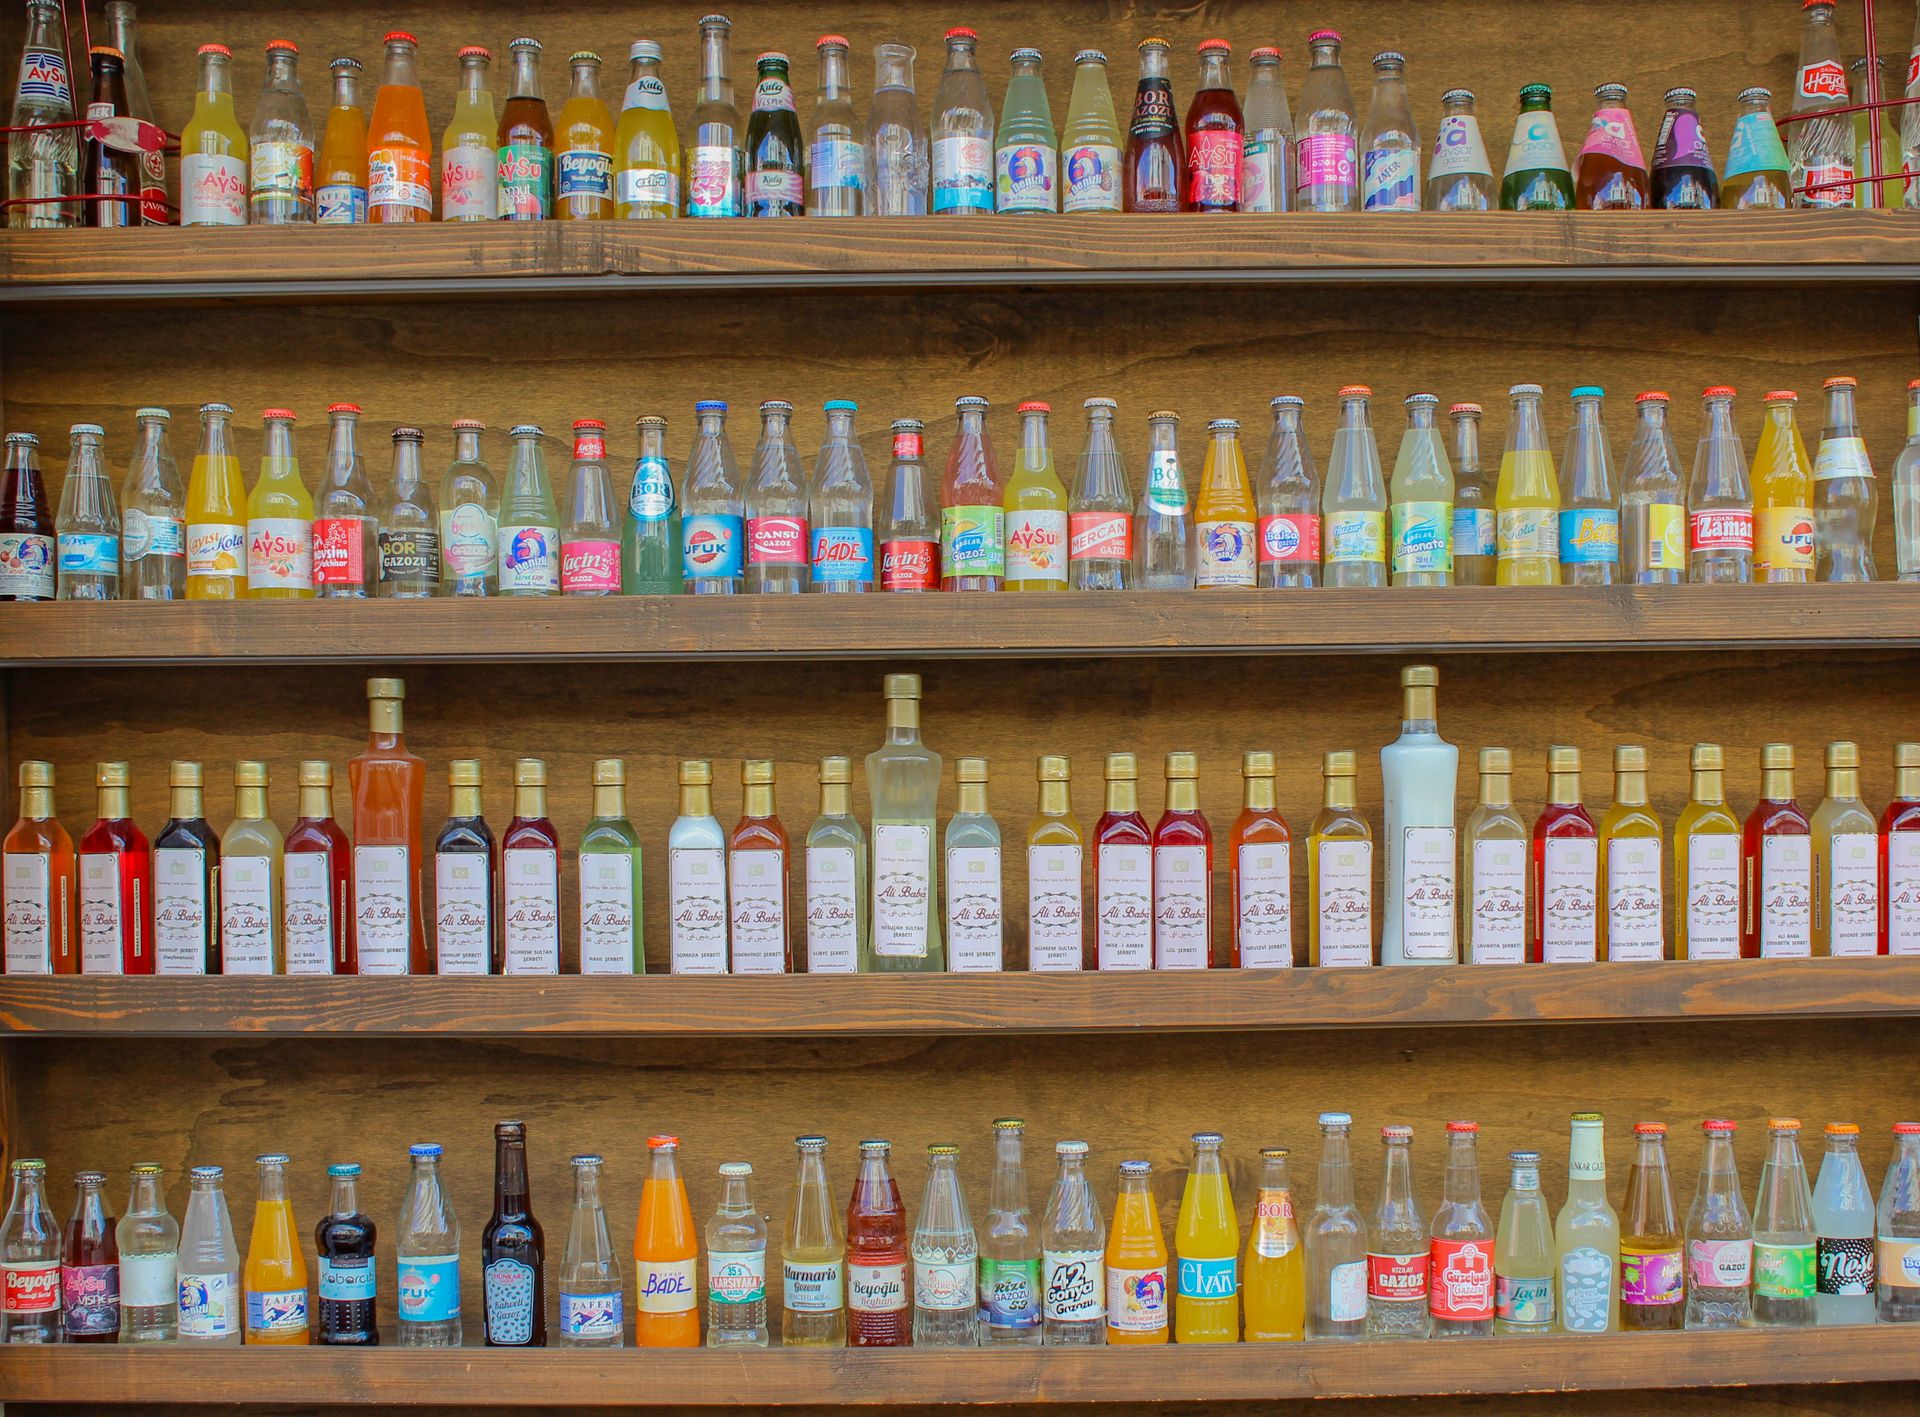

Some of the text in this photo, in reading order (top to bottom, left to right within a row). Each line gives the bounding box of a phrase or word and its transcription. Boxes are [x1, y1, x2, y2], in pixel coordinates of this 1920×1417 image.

[28, 67, 66, 84] AySu
[638, 80, 664, 94] Kula
[759, 82, 785, 96] Kula
[1189, 145, 1236, 169] AySu
[498, 158, 541, 181] AySu
[1377, 161, 1400, 184] ZAFER
[203, 171, 246, 195] AySu
[763, 175, 785, 185] Kula
[319, 190, 350, 201] AFER
[634, 483, 667, 495] BOR
[755, 531, 799, 539] CANSU
[1072, 521, 1125, 550] MERCAN
[1333, 522, 1363, 537] Huzur
[212, 535, 243, 551] Kola
[1010, 529, 1055, 549] AySu
[1266, 532, 1298, 542] Balsa
[1781, 535, 1813, 544] UFU
[252, 537, 296, 557] AySu
[383, 542, 416, 555] BOR
[684, 543, 727, 555] UFUK
[1278, 540, 1298, 549] gazoz
[1396, 539, 1444, 558] Limonata
[813, 538, 868, 567] BADE
[952, 549, 985, 561] Gazoz
[1100, 547, 1125, 555] GAZOZ
[384, 557, 426, 567] GAZOZU
[877, 885, 927, 898] Ali Baba
[1407, 888, 1454, 900] Ali Baba
[1242, 903, 1289, 917] Ali Baba
[1322, 901, 1369, 913] Ali Baba
[1476, 900, 1524, 913] Ali Baba
[1547, 899, 1565, 911] Ali
[1632, 899, 1659, 911] Baba
[175, 909, 202, 921] Baba
[378, 907, 406, 919] Baba
[508, 909, 555, 921] Ali Baba
[675, 909, 723, 921] Ali Baba
[734, 910, 781, 923] Ali Baba
[808, 907, 854, 919] Ali Baba
[952, 908, 1000, 920] Ali Baba
[1032, 906, 1080, 918] Ali Baba
[1101, 906, 1150, 918] Ali Baba
[1157, 906, 1205, 919] Ali Baba
[241, 916, 269, 928] Baba
[301, 914, 328, 925] Baba
[438, 914, 485, 926] Ali Baba
[583, 914, 630, 926] Ali Baba
[1258, 1203, 1293, 1219] BOR
[727, 1266, 736, 1276] 35
[1719, 1263, 1746, 1271] GAZOZ
[1052, 1261, 1086, 1286] 42
[67, 1276, 106, 1295] AySu
[641, 1274, 691, 1297] BADE
[995, 1280, 1027, 1293] Rize
[1380, 1273, 1424, 1288] GAZOZ
[854, 1280, 899, 1297] Beyoğlu
[265, 1295, 304, 1306] ZAFER
[994, 1290, 1029, 1301] GAZOZU
[572, 1301, 612, 1310] ZAFER
[1009, 1300, 1027, 1310] 53
